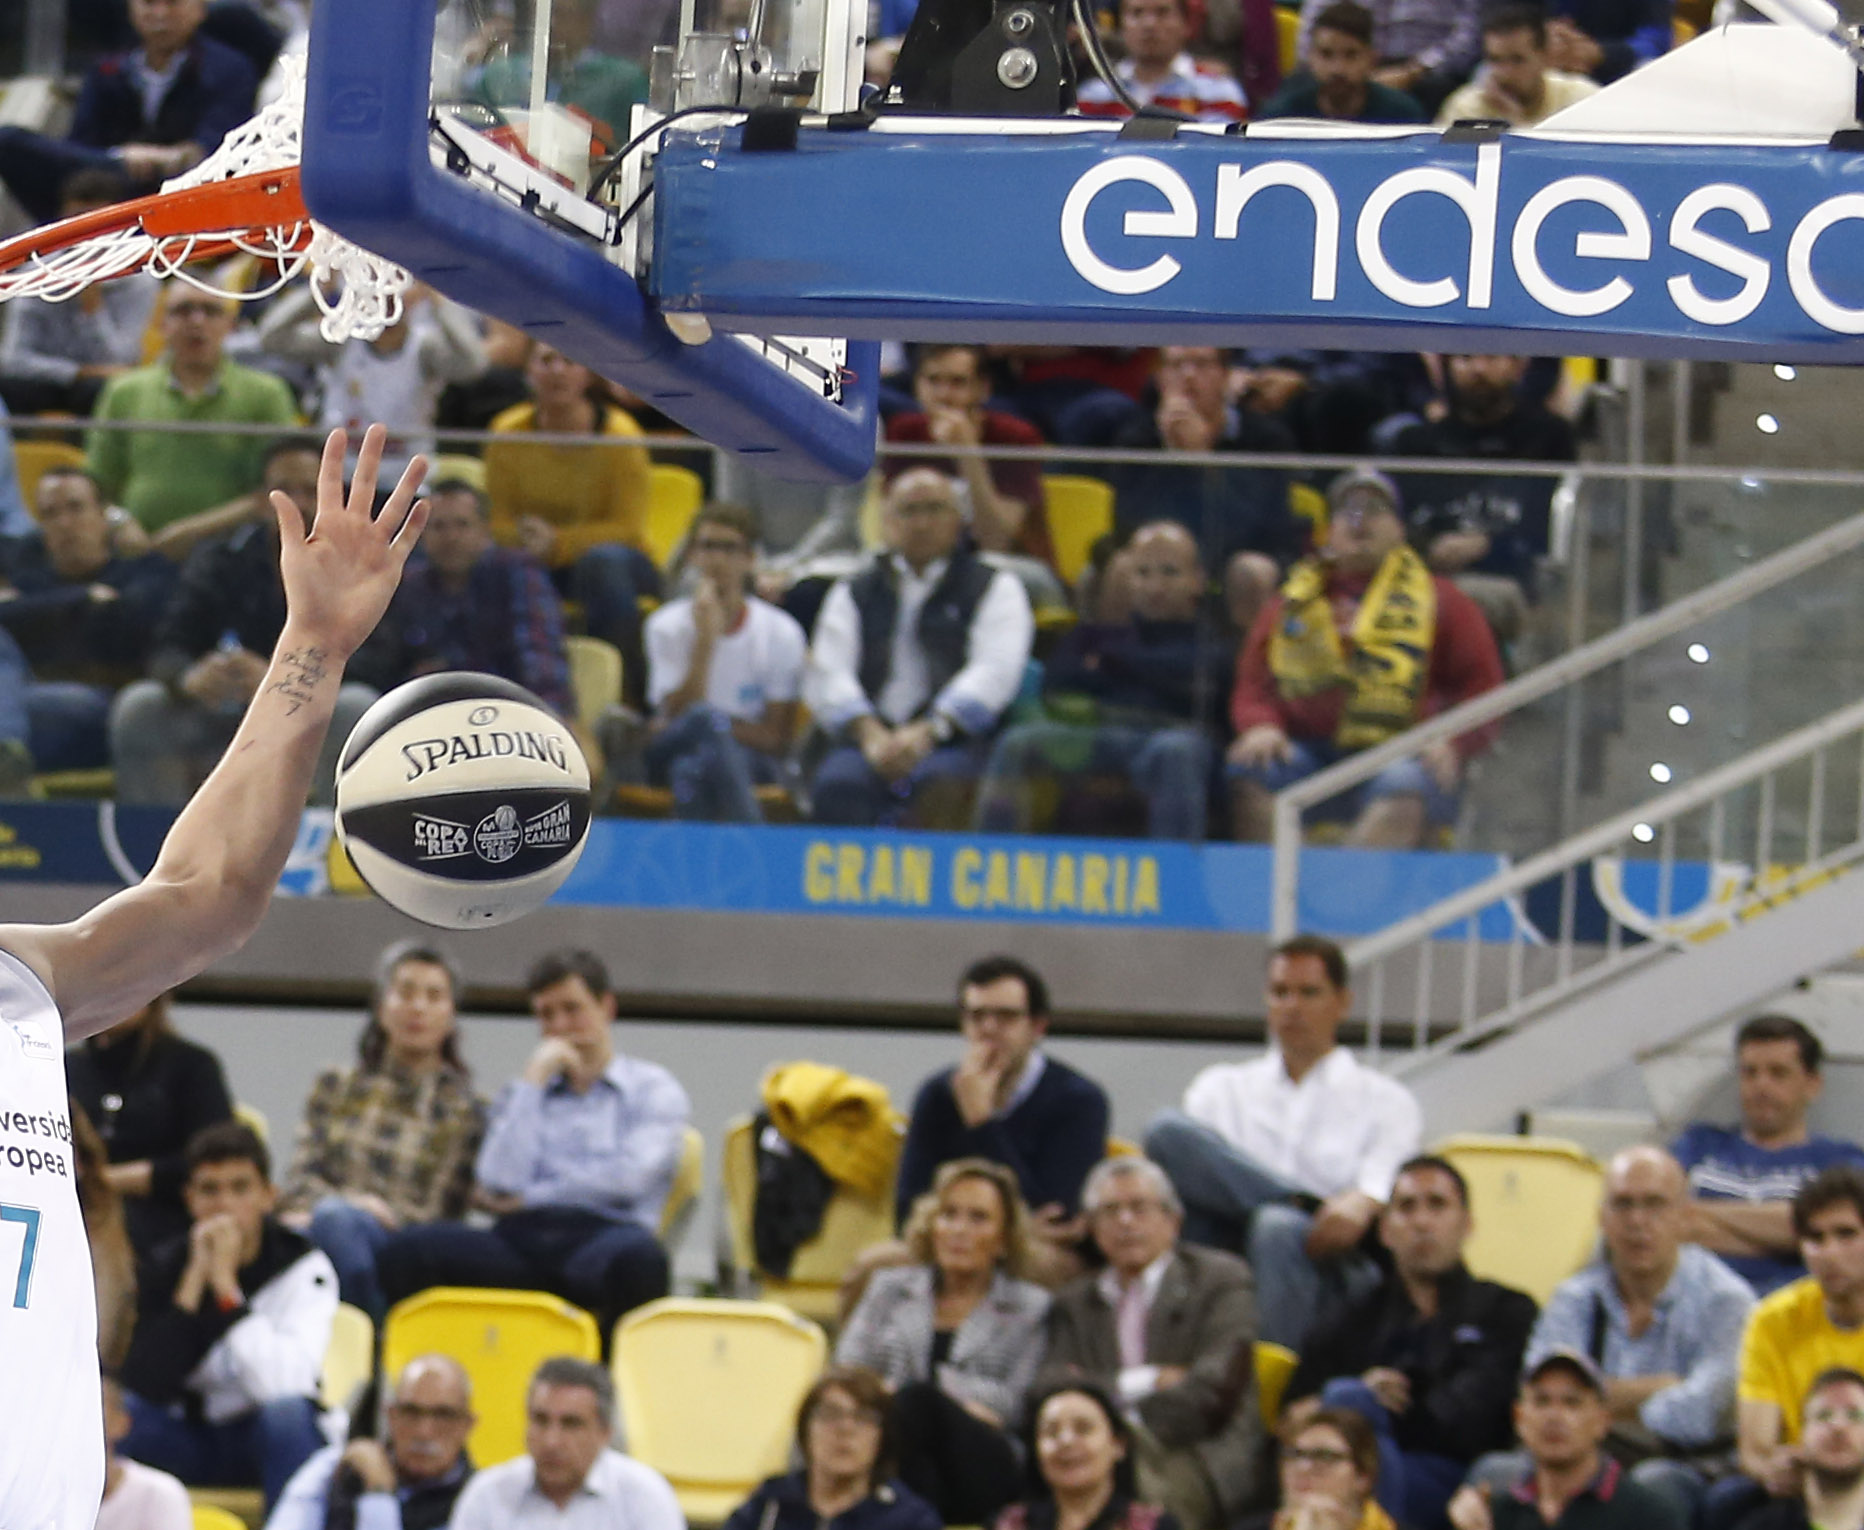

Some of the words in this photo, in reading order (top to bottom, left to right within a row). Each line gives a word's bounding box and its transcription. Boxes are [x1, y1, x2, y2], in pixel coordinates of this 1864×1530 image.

[400, 731, 571, 782] SPALDING
[542, 802, 571, 830] GRAN
[414, 820, 468, 840] COPA
[524, 823, 571, 844] CANARIA
[427, 838, 468, 856] REY
[803, 839, 932, 906] GRAN
[949, 846, 1161, 915] CANARIA
